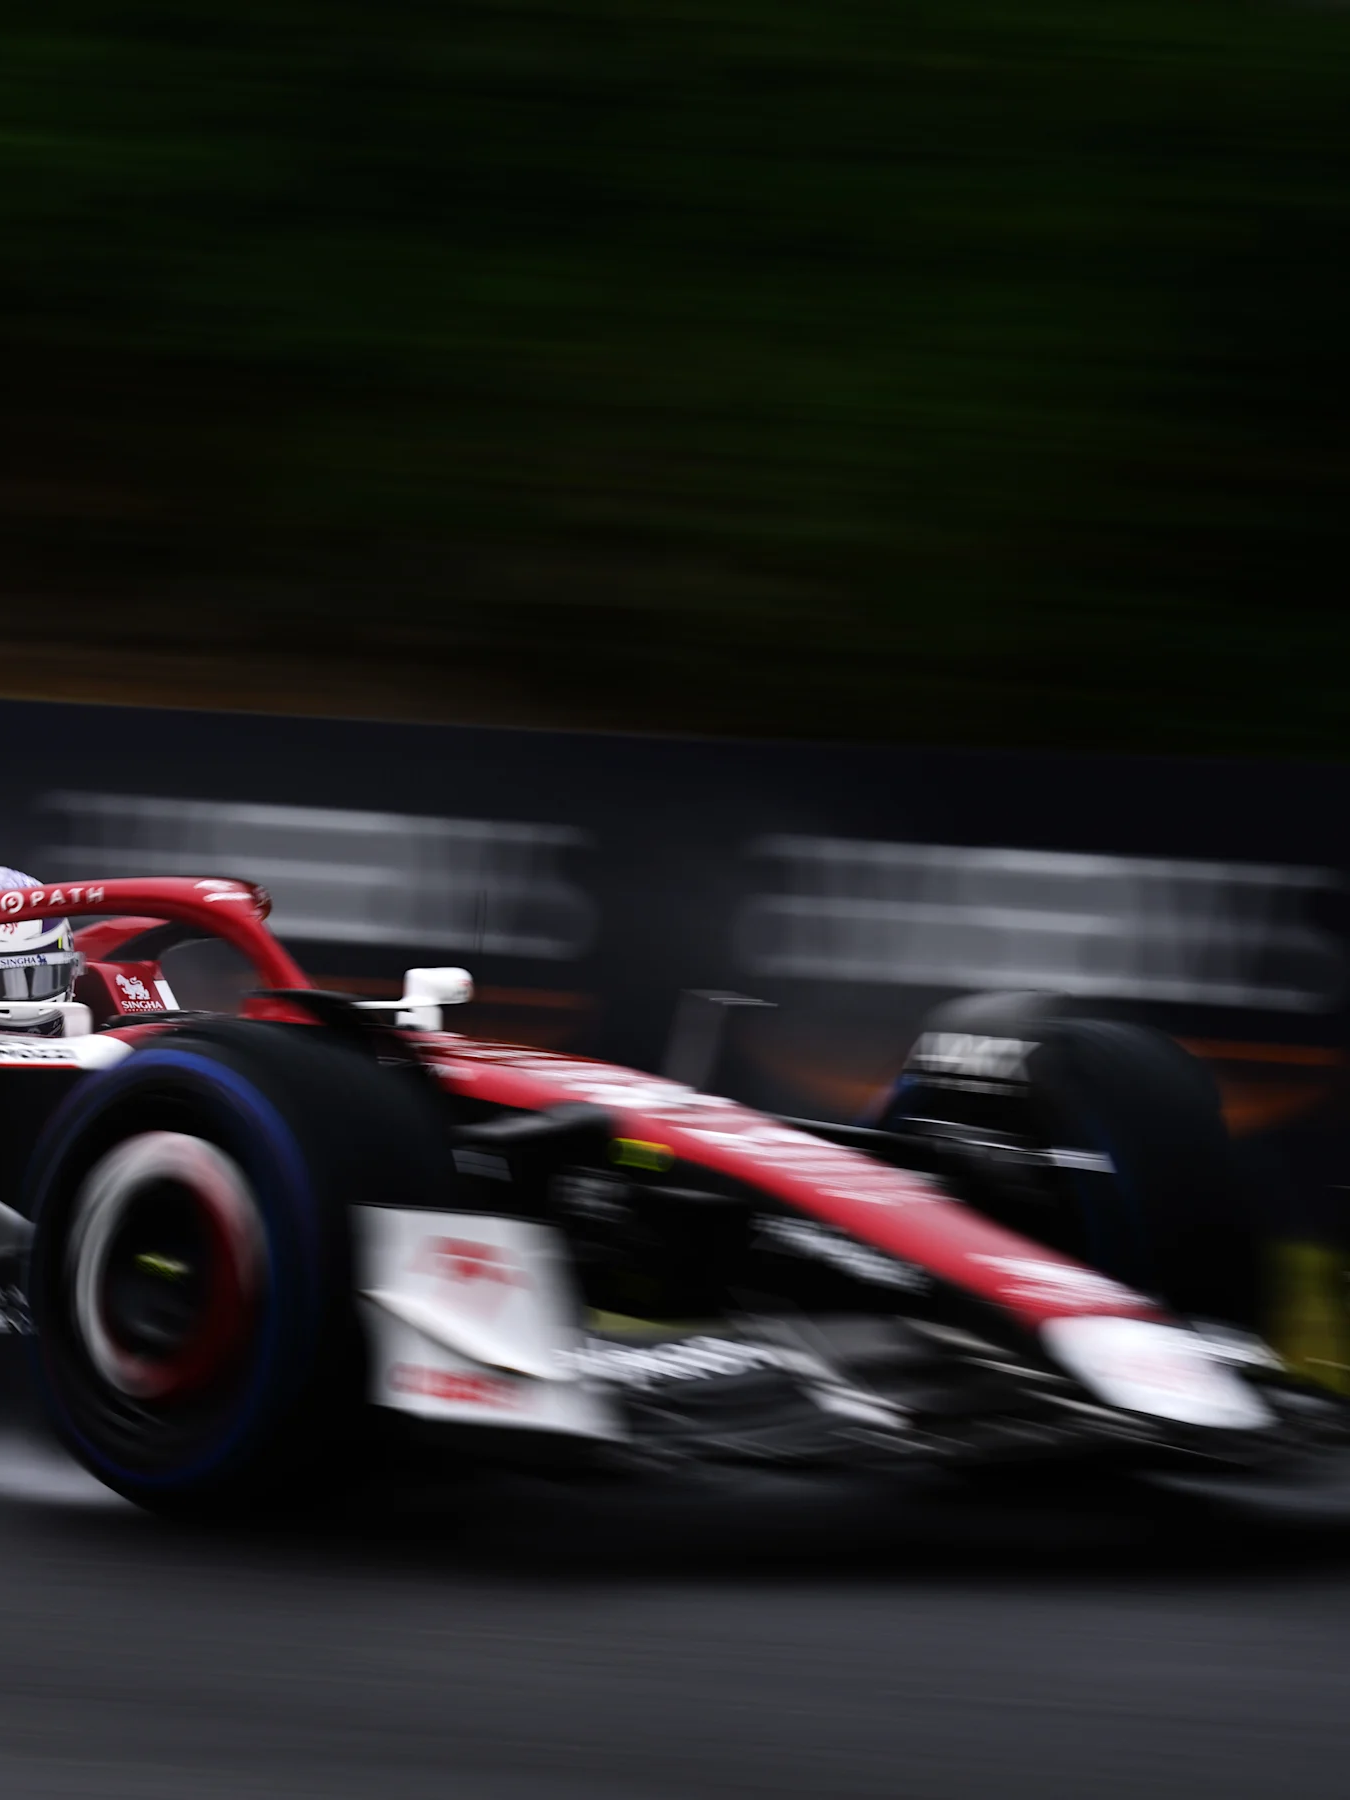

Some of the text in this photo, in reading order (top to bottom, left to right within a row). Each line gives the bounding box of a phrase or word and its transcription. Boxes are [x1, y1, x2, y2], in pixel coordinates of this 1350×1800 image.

[30, 887, 104, 907] PATH
[0, 957, 37, 967] SINGHA
[121, 1001, 163, 1009] SINGHA
